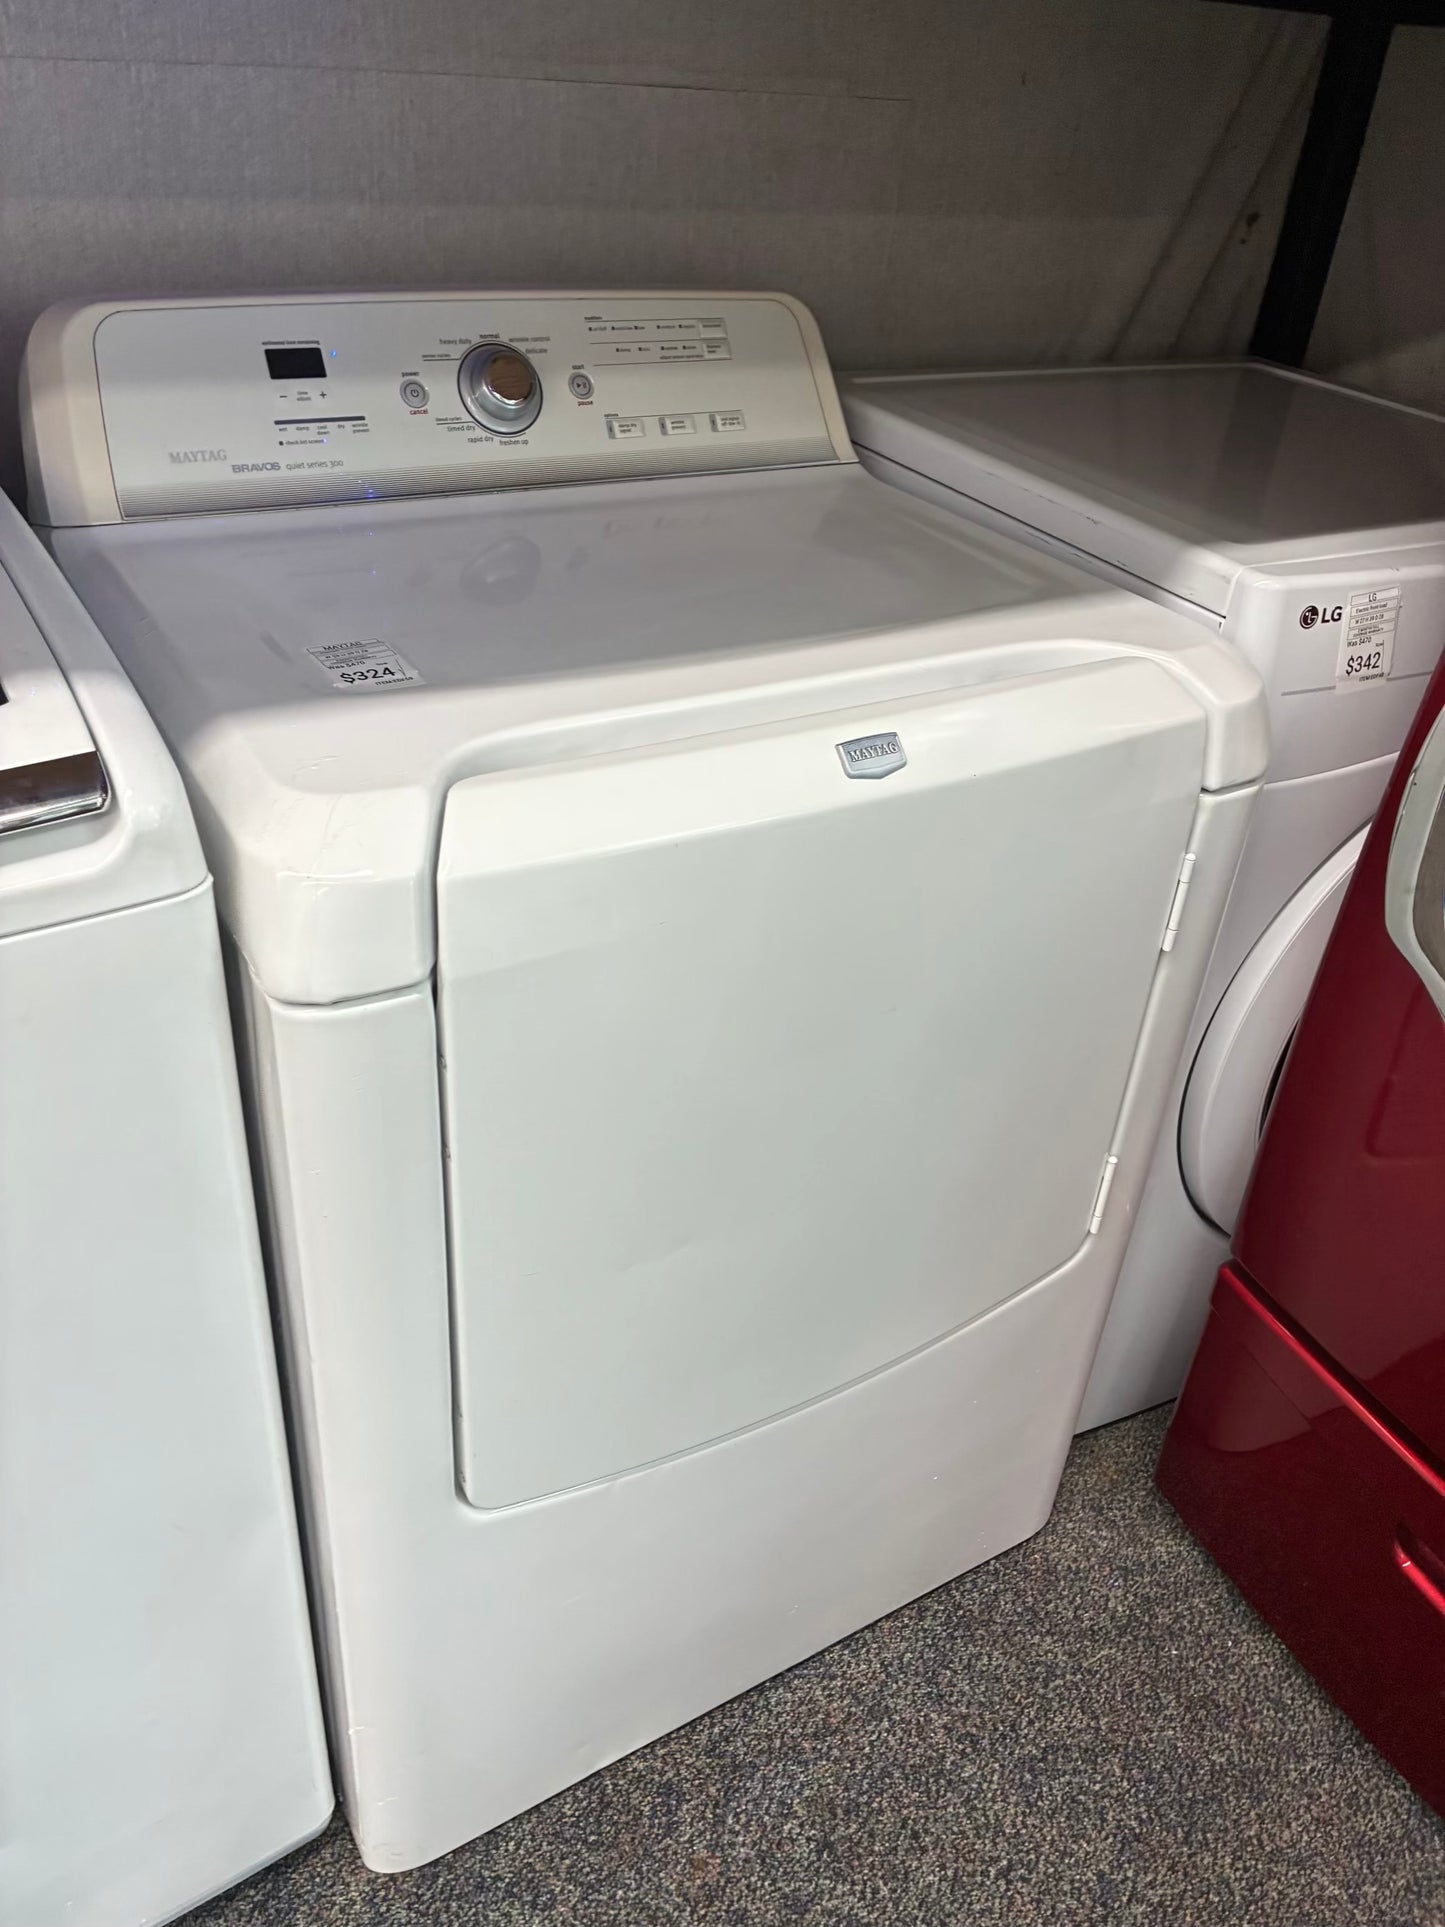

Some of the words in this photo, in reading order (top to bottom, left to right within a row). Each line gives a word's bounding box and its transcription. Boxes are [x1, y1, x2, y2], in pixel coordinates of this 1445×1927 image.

[409, 408, 429, 416] cancel
[466, 425, 476, 433] dry
[467, 436, 484, 444] rapid
[169, 449, 227, 465] MAYTAG
[231, 461, 281, 474] BRAVOS
[286, 462, 305, 472] quiet
[306, 460, 328, 470] series
[329, 459, 344, 468] 300
[1368, 592, 1377, 602] LG
[1321, 606, 1343, 624] LG
[322, 641, 362, 651] MAYTAG
[1346, 651, 1381, 676] $342
[340, 667, 396, 684] $324
[848, 742, 899, 763] MAYTAG
